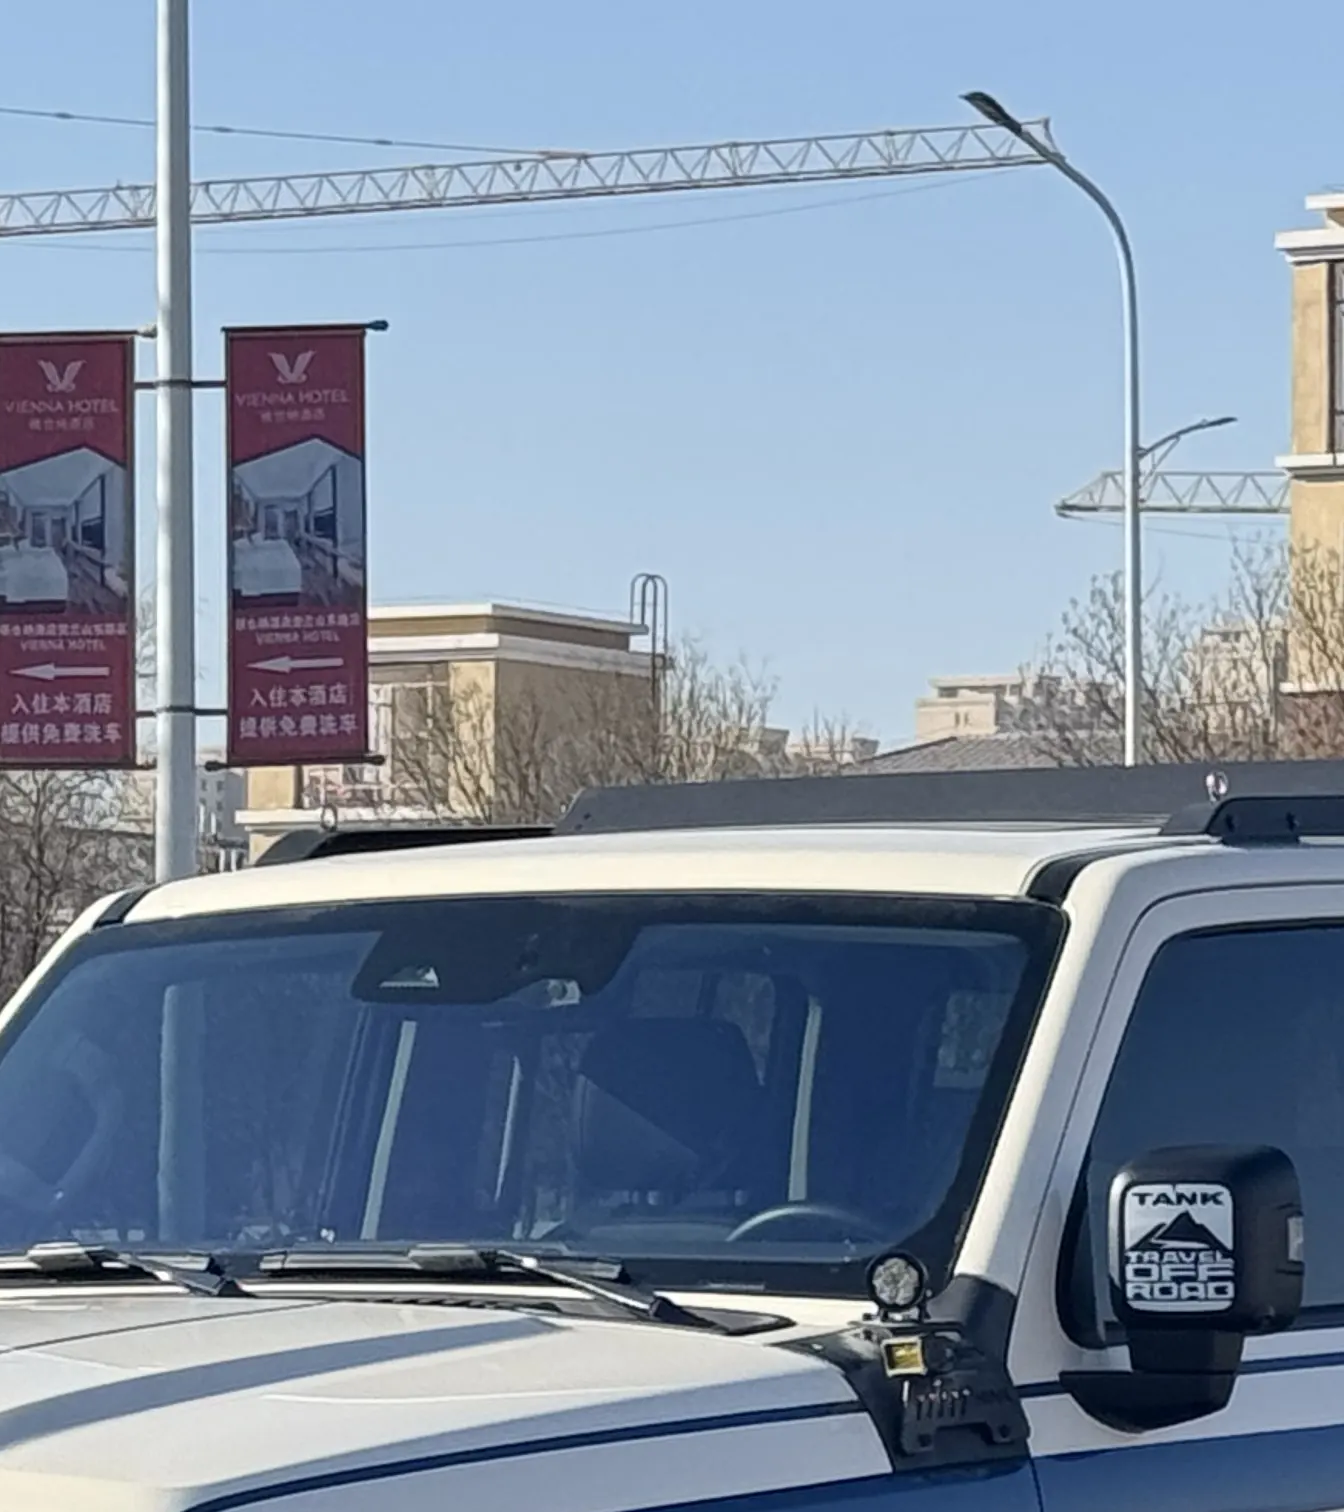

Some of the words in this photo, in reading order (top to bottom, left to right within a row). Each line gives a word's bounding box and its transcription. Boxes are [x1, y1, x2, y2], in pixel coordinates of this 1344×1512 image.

[5, 400, 64, 414] VIENNA
[68, 398, 120, 412] HOTEL
[235, 393, 294, 407] VIENNA
[298, 389, 350, 404] HOTEL
[68, 638, 107, 652] HOTEL
[302, 630, 341, 643] HOTEL
[11, 692, 113, 715] 入住本酒店
[249, 682, 348, 708] 入住本酒店
[0, 721, 123, 745] 提供免费洗车
[239, 713, 358, 738] 提供免费洗车
[1132, 1191, 1224, 1207] TANK
[1125, 1250, 1234, 1264] TRAVEL
[1125, 1262, 1235, 1282] OFF
[1125, 1281, 1236, 1300] ROAD
